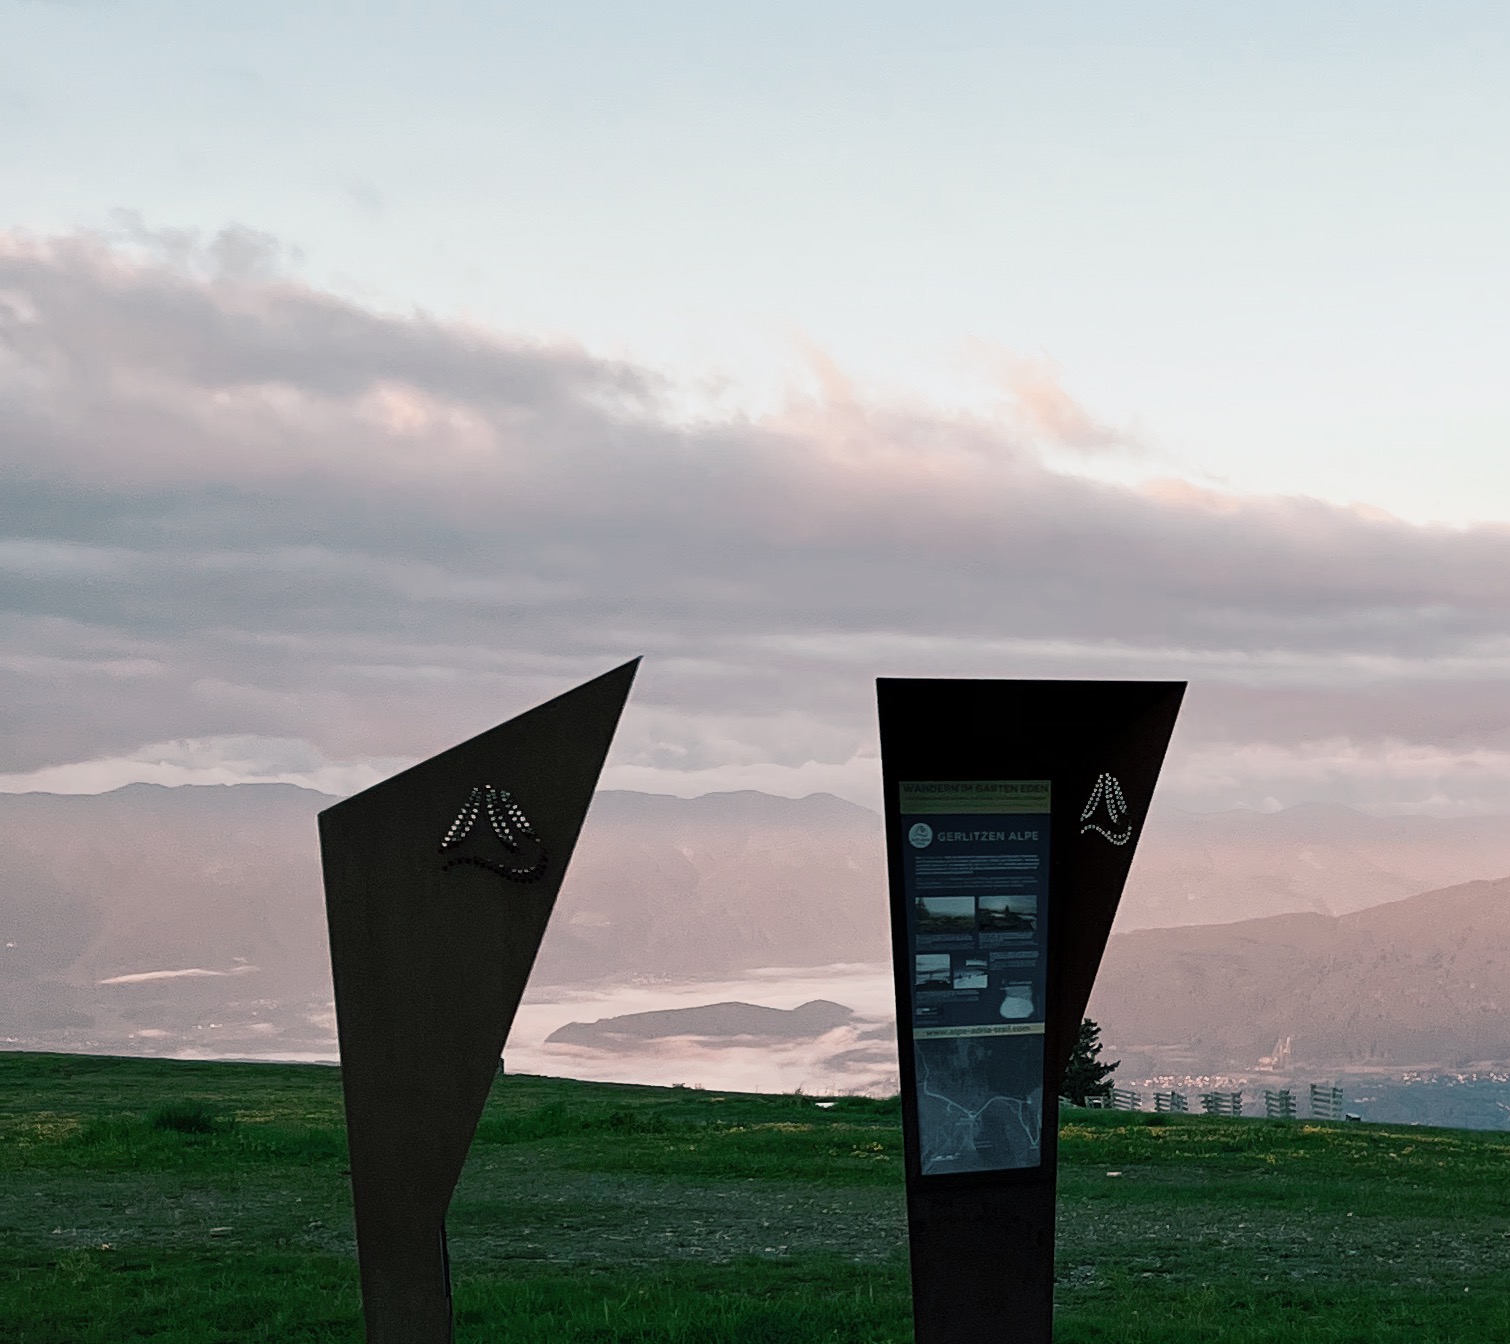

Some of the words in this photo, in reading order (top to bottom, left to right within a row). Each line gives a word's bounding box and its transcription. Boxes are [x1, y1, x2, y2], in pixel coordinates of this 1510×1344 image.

[903, 784, 959, 794] WANDERN
[975, 784, 1018, 793] GARTEN
[1020, 784, 1049, 793] EDEN
[937, 831, 1005, 842] GERLITZEN
[1008, 831, 1039, 841] ALPE
